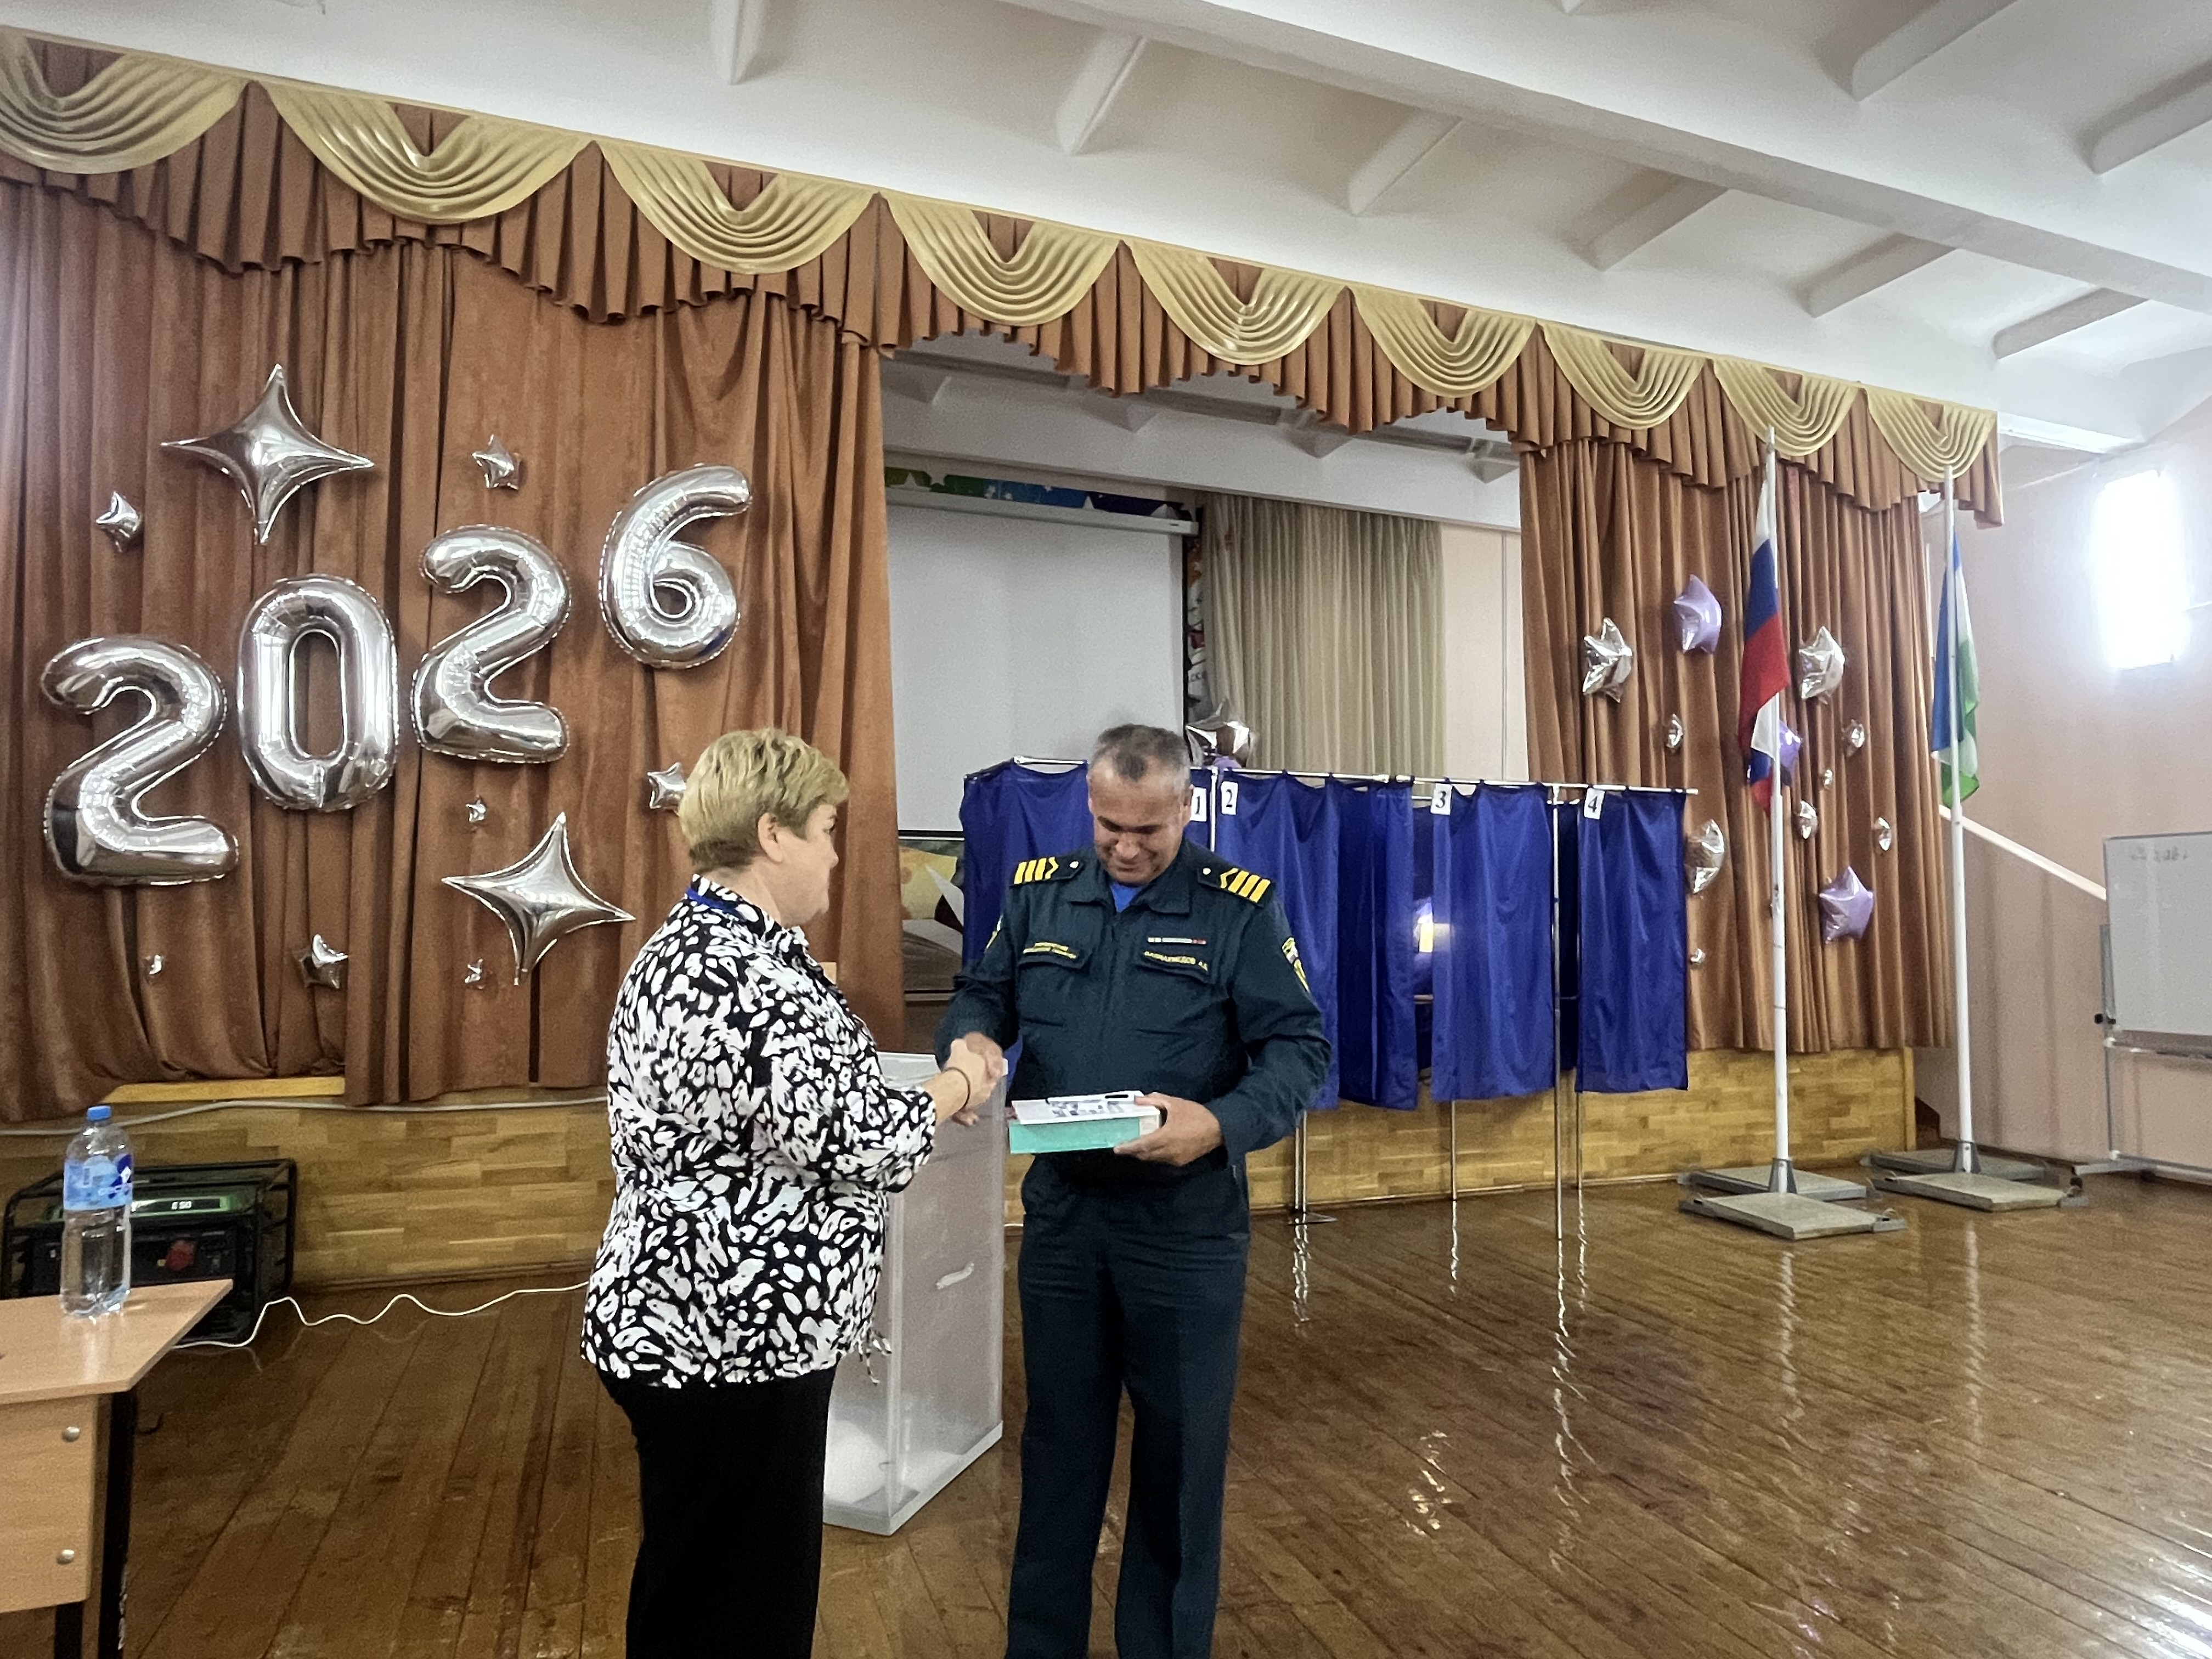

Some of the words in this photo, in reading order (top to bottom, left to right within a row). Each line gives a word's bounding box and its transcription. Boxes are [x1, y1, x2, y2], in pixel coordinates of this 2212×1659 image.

[41, 462, 752, 887] 2026
[1195, 795, 1201, 815] 1
[1226, 789, 1233, 808] 2
[1435, 791, 1447, 808] 3
[1588, 795, 1598, 813] 4
